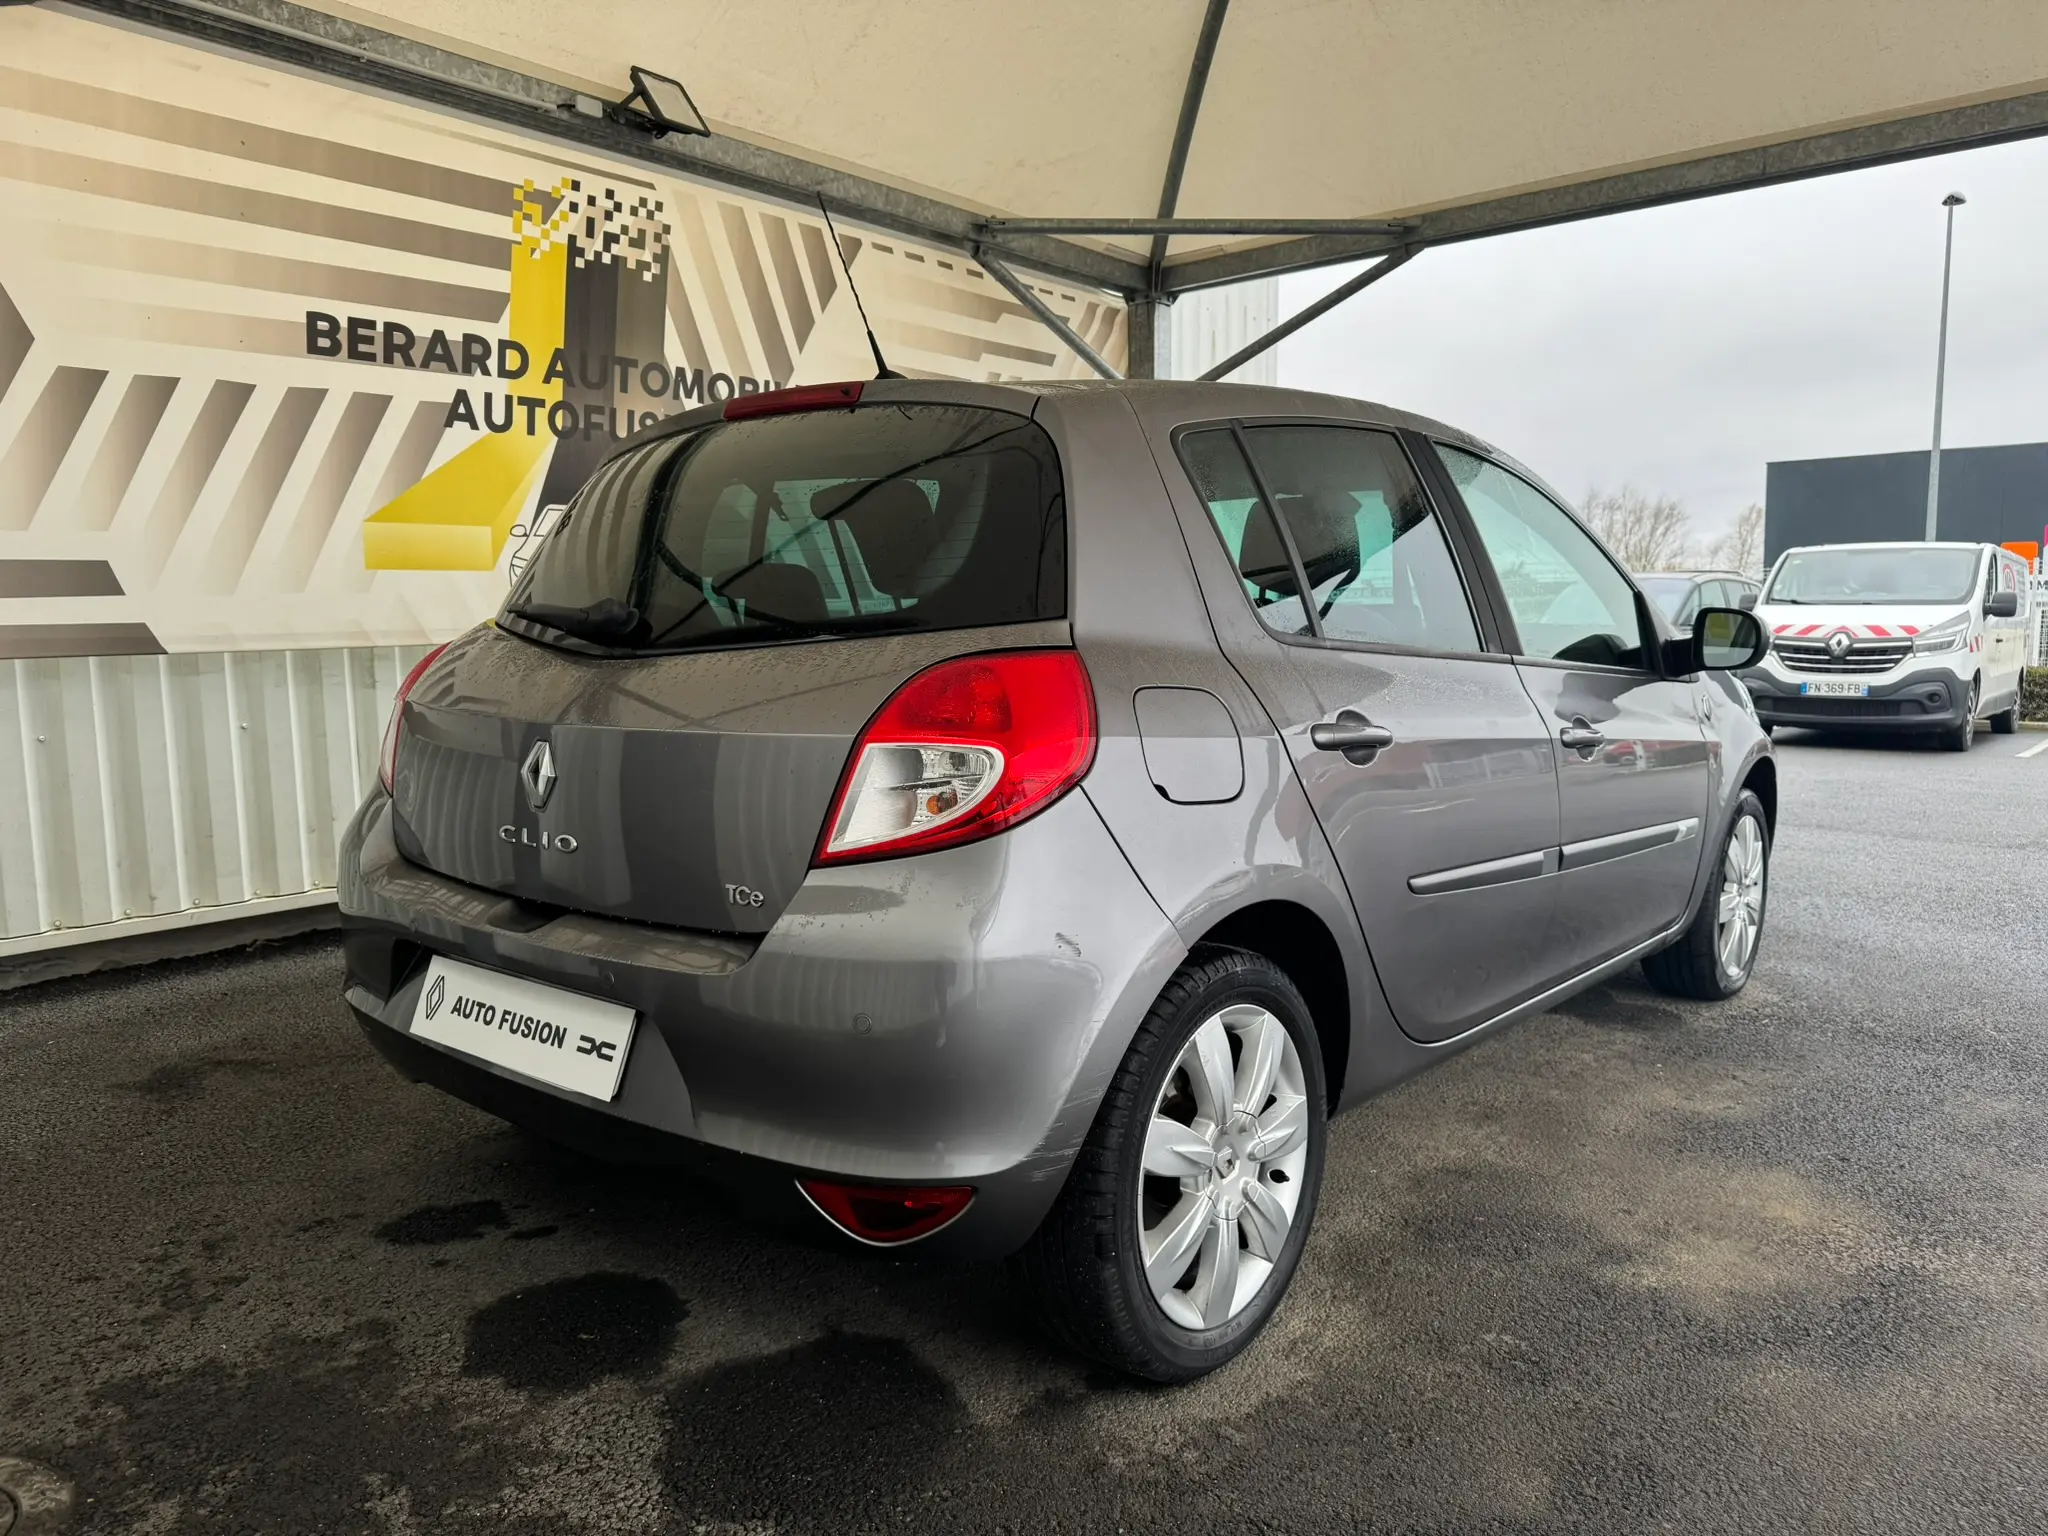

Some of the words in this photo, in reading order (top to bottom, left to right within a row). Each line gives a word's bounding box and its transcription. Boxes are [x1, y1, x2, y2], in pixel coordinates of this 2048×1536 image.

[305, 311, 530, 380] BERARD
[499, 825, 578, 853] CLIO
[725, 883, 765, 908] TCe
[450, 995, 496, 1026] AUTO
[498, 1009, 568, 1049] FUSION
